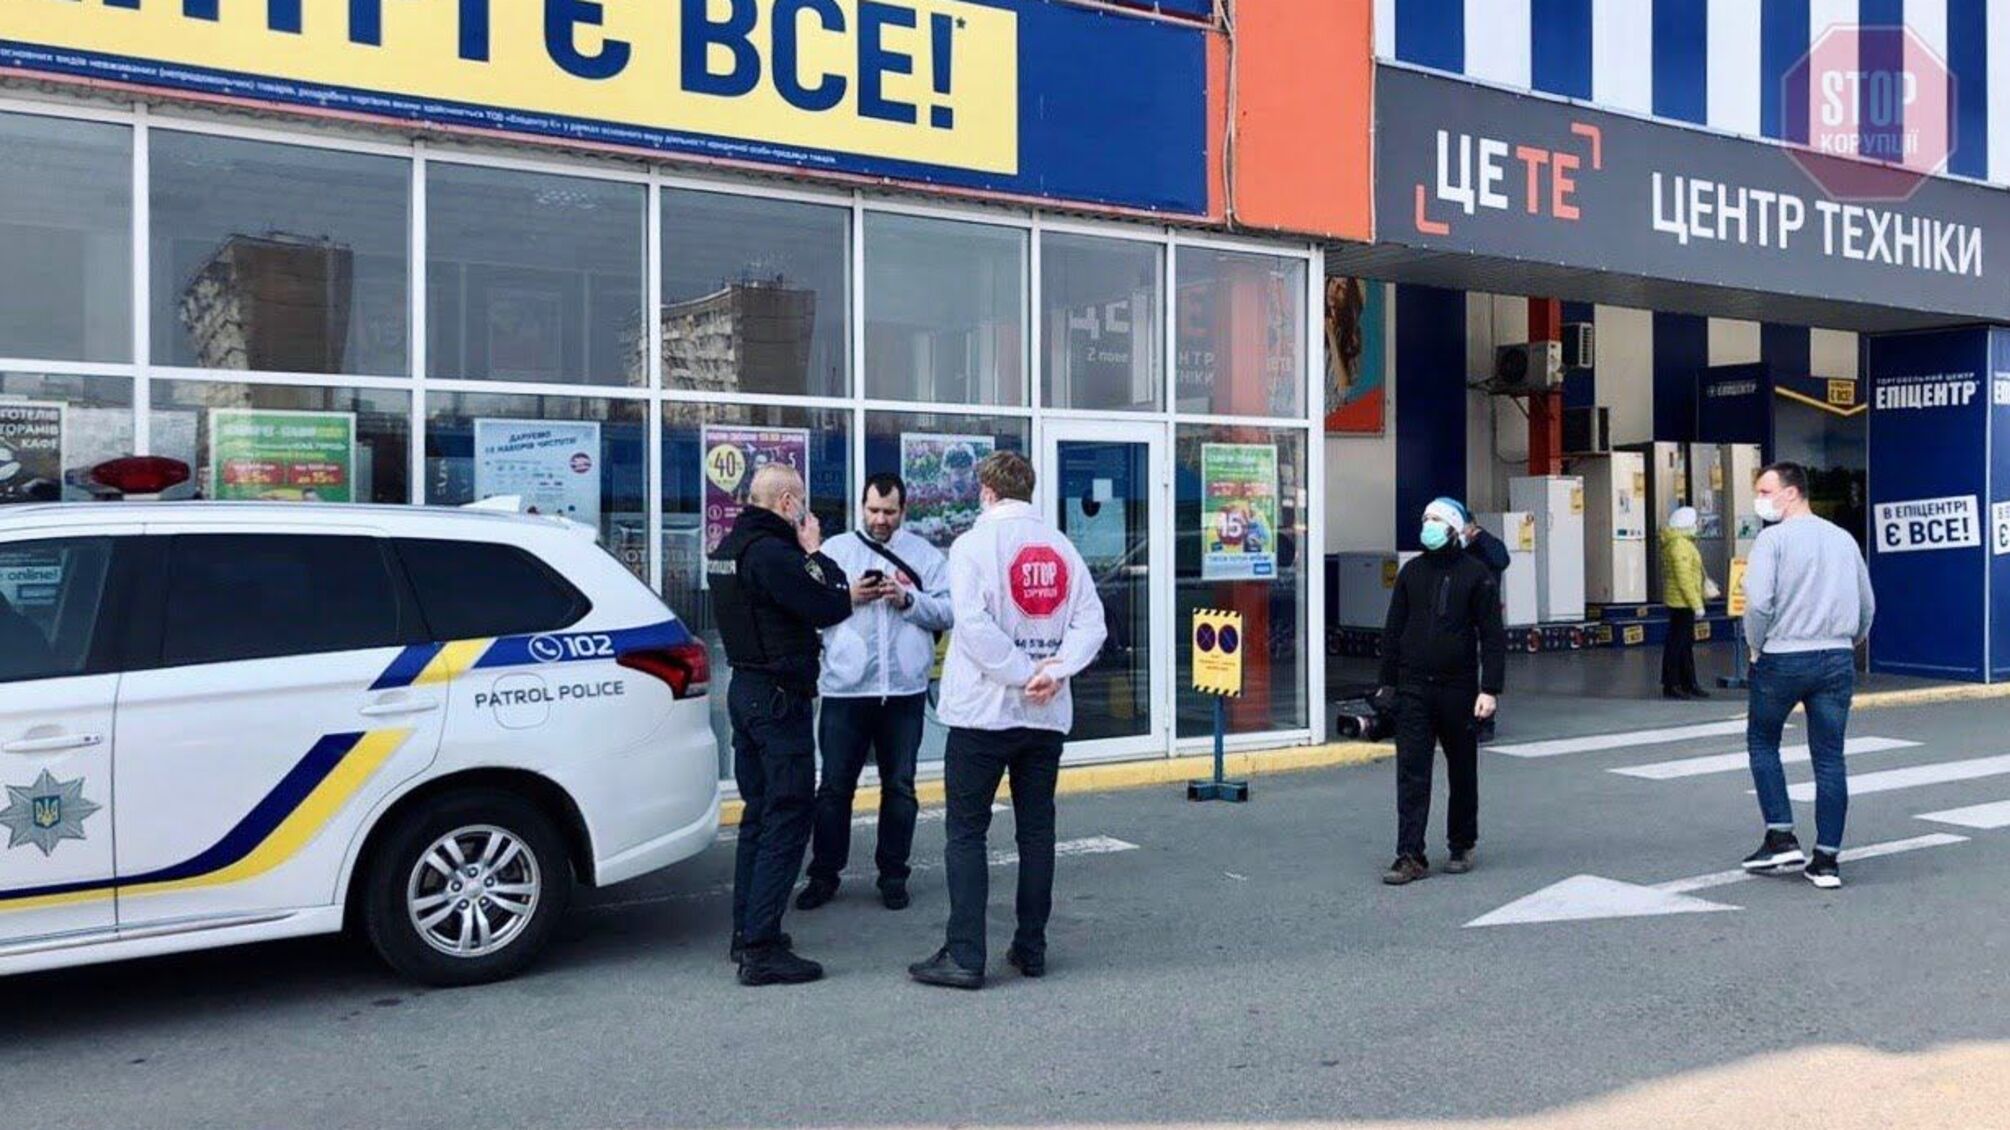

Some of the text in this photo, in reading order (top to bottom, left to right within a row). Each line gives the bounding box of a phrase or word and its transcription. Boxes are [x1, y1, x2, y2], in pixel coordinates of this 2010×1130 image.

[1651, 171, 1984, 277] ЦЕНТР ТЕХНІКИ
[1876, 381, 1977, 410] ЕПІЦЕНТР
[713, 451, 736, 478] 40
[1883, 501, 1968, 520] В ЕПІЦЕНТРІ
[1216, 511, 1244, 538] 15
[1885, 517, 1970, 547] Є ВСЕ!
[1022, 561, 1058, 588] STOP
[563, 634, 614, 657] 102
[474, 680, 624, 708] PATROL POLICE
